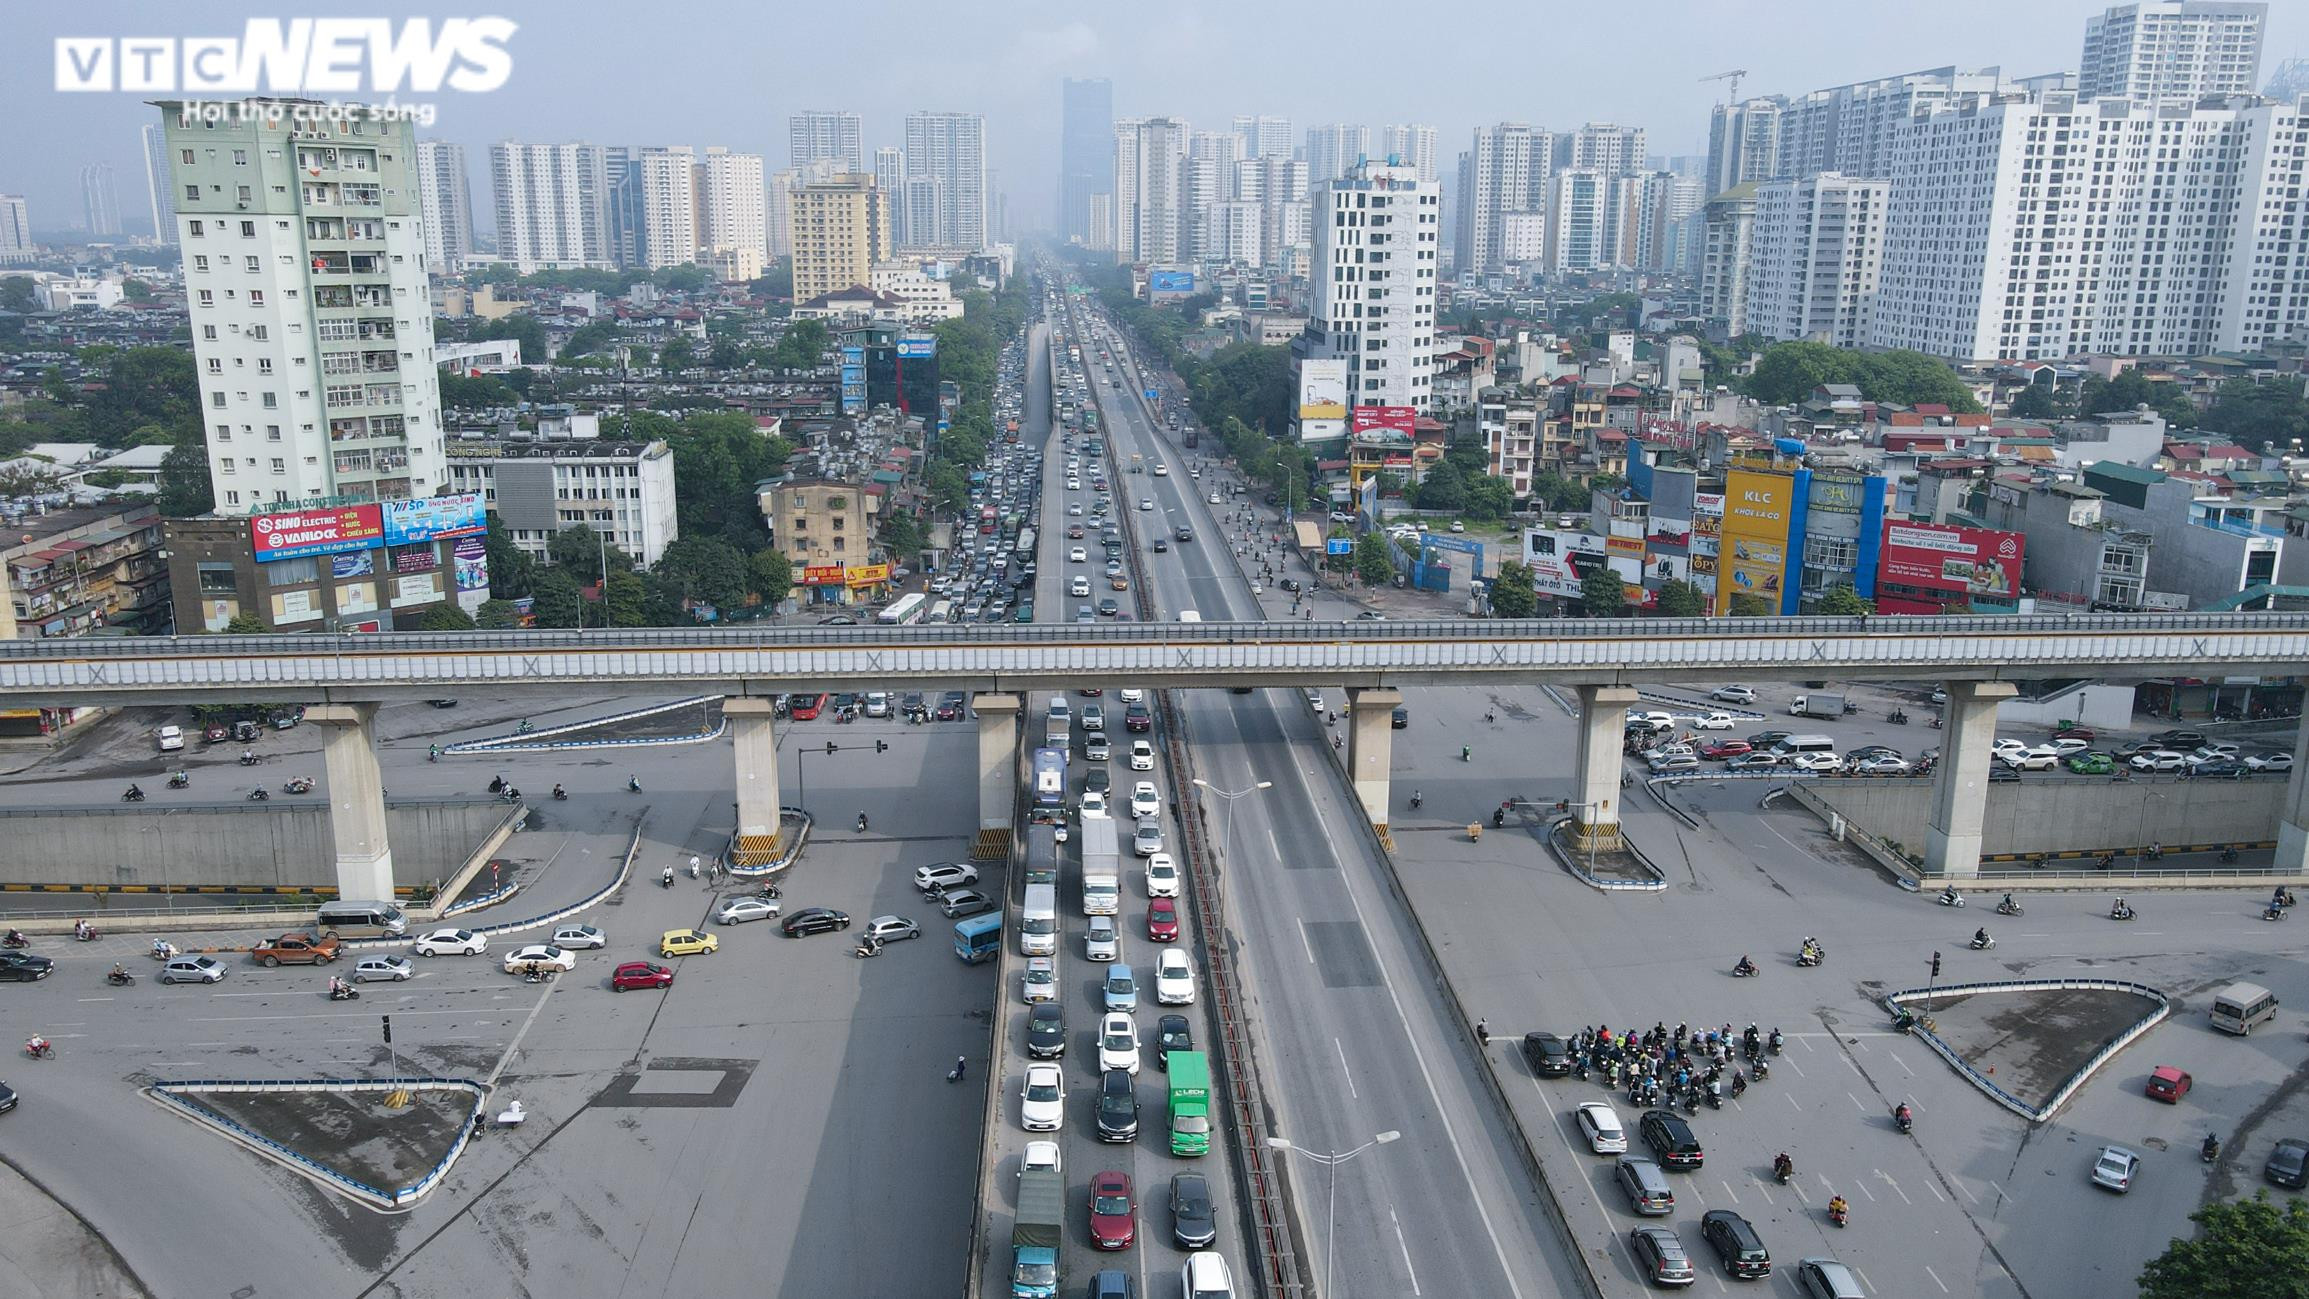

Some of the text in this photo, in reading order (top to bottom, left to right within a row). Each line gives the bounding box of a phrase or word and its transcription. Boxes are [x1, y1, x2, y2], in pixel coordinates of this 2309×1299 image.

[1744, 490, 1772, 504] KLC
[409, 500, 424, 511] SP
[274, 516, 337, 531] SINO ELECTRIC
[284, 528, 339, 545] VANLOCK
[1891, 528, 1958, 541] Batdongsan.com.vn
